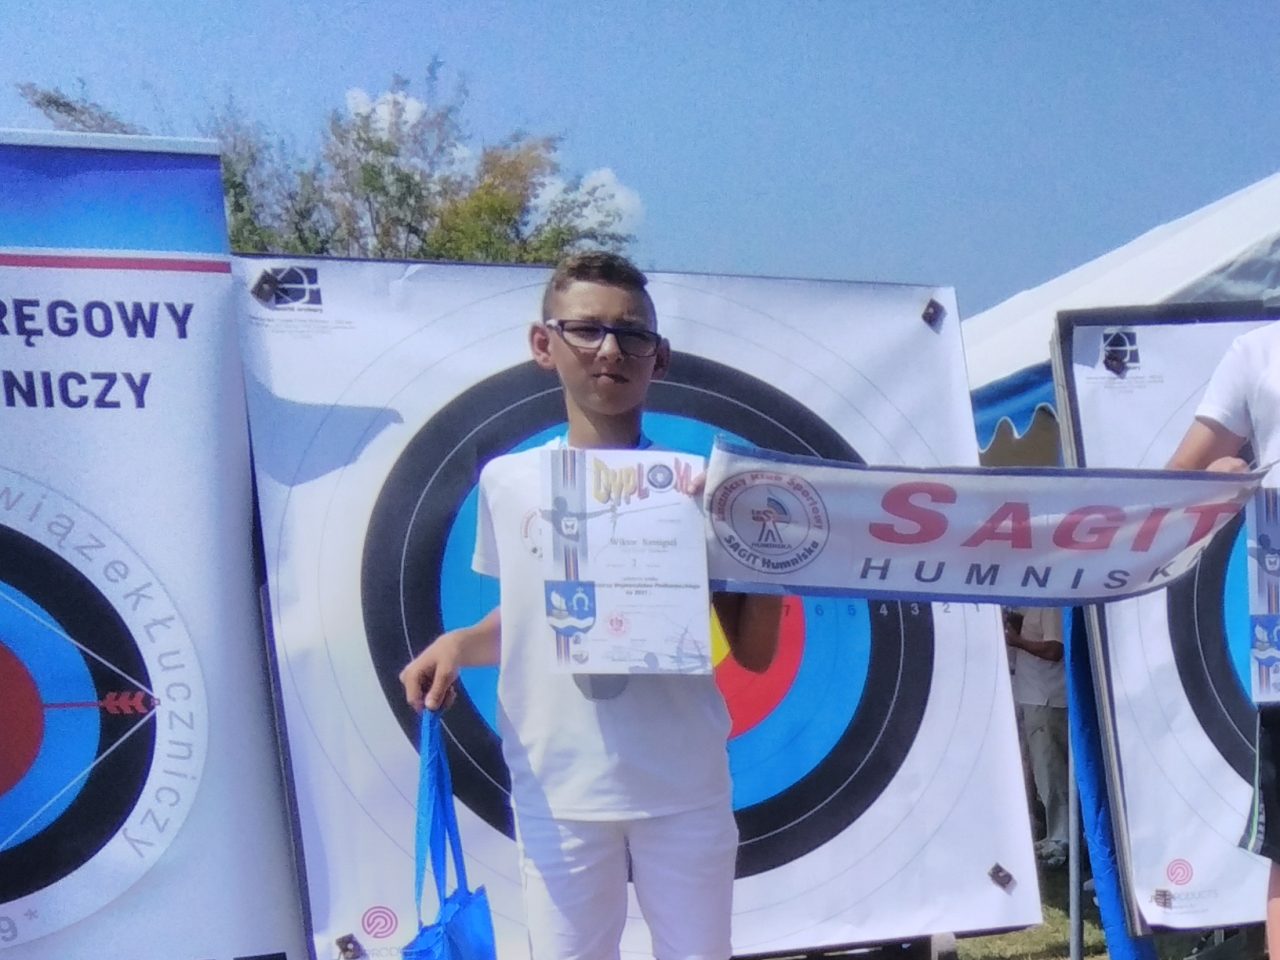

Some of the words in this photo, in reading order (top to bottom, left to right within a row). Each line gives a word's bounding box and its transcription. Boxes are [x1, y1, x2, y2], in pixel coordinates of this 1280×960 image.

[2, 369, 152, 409] NICZY
[868, 481, 1241, 552] SAGIT
[880, 604, 889, 617] 4
[911, 604, 920, 616] 3
